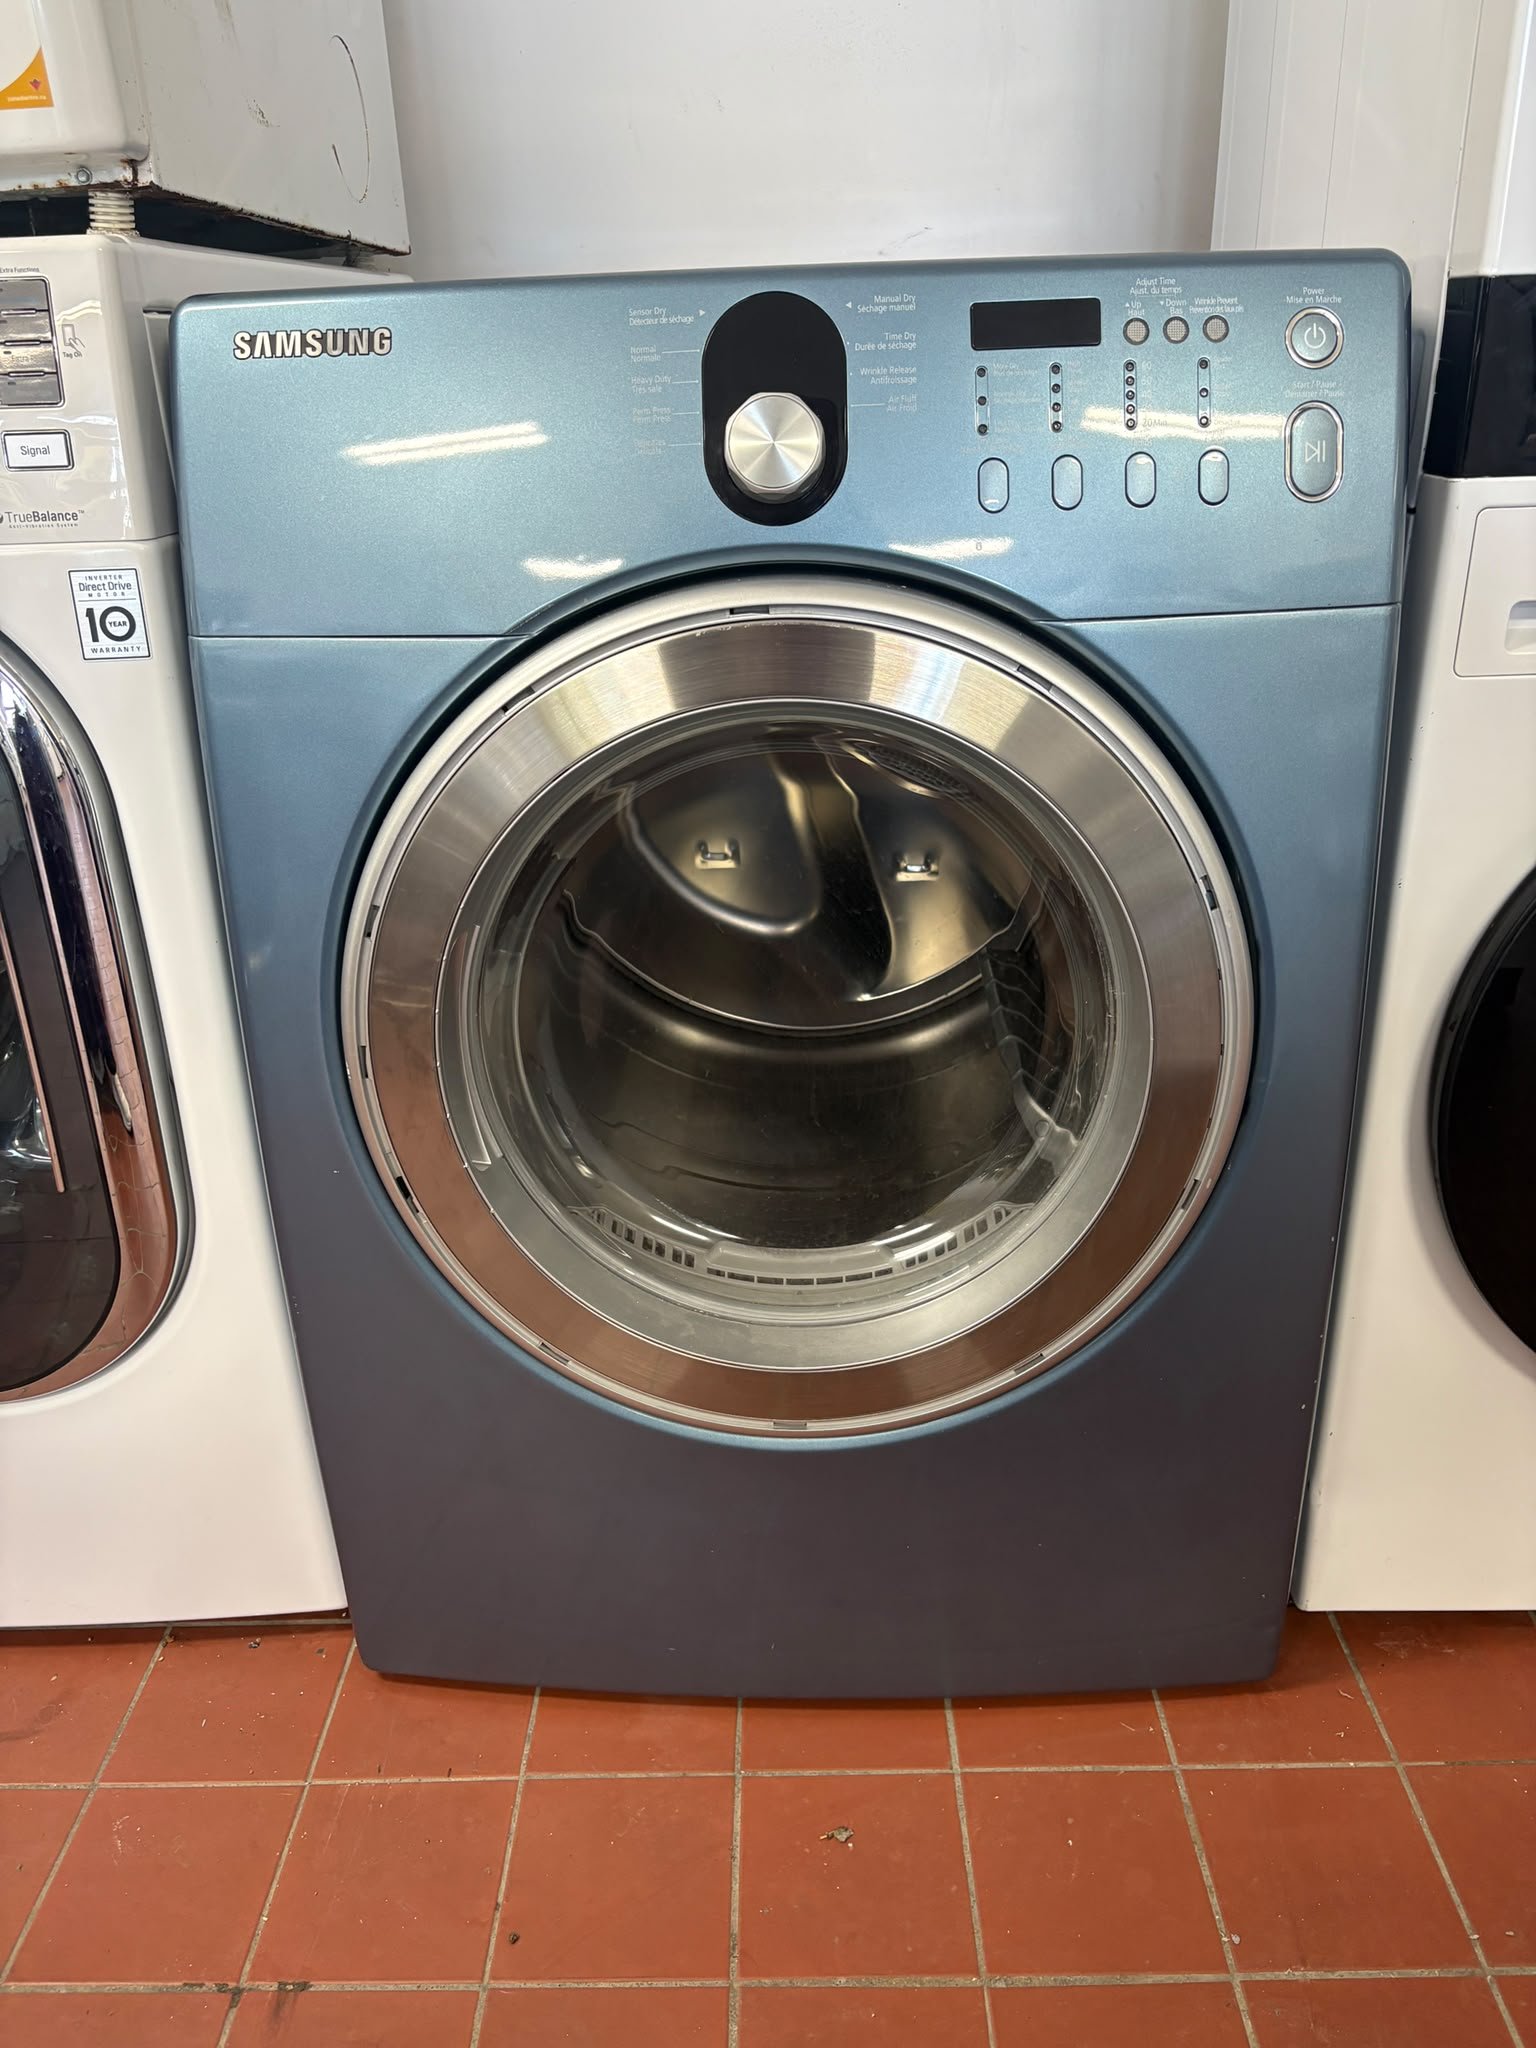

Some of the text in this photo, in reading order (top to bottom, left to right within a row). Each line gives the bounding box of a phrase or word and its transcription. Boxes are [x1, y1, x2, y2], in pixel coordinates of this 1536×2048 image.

[1136, 277, 1176, 287] Adjust Time
[1151, 286, 1160, 294] du
[1162, 286, 1182, 294] temps
[1303, 287, 1324, 295] Power
[874, 293, 916, 303] Manual Dry
[1316, 296, 1342, 304] Marche
[889, 303, 916, 311] manuel
[1131, 302, 1142, 310] Up
[629, 307, 666, 316] Sensor Dry
[884, 332, 916, 341] Time Dry
[233, 327, 392, 360] SAMSUNG
[855, 341, 916, 350] Durée de séchage
[630, 345, 656, 354] Normal
[630, 354, 661, 362] Normale
[860, 366, 916, 375] Wrinkle Release
[632, 375, 672, 384] Heavy Duty
[870, 376, 917, 385] Antifroissage
[20, 445, 50, 457] Signal
[78, 582, 132, 592] Direct Drive
[86, 606, 136, 642] 10
